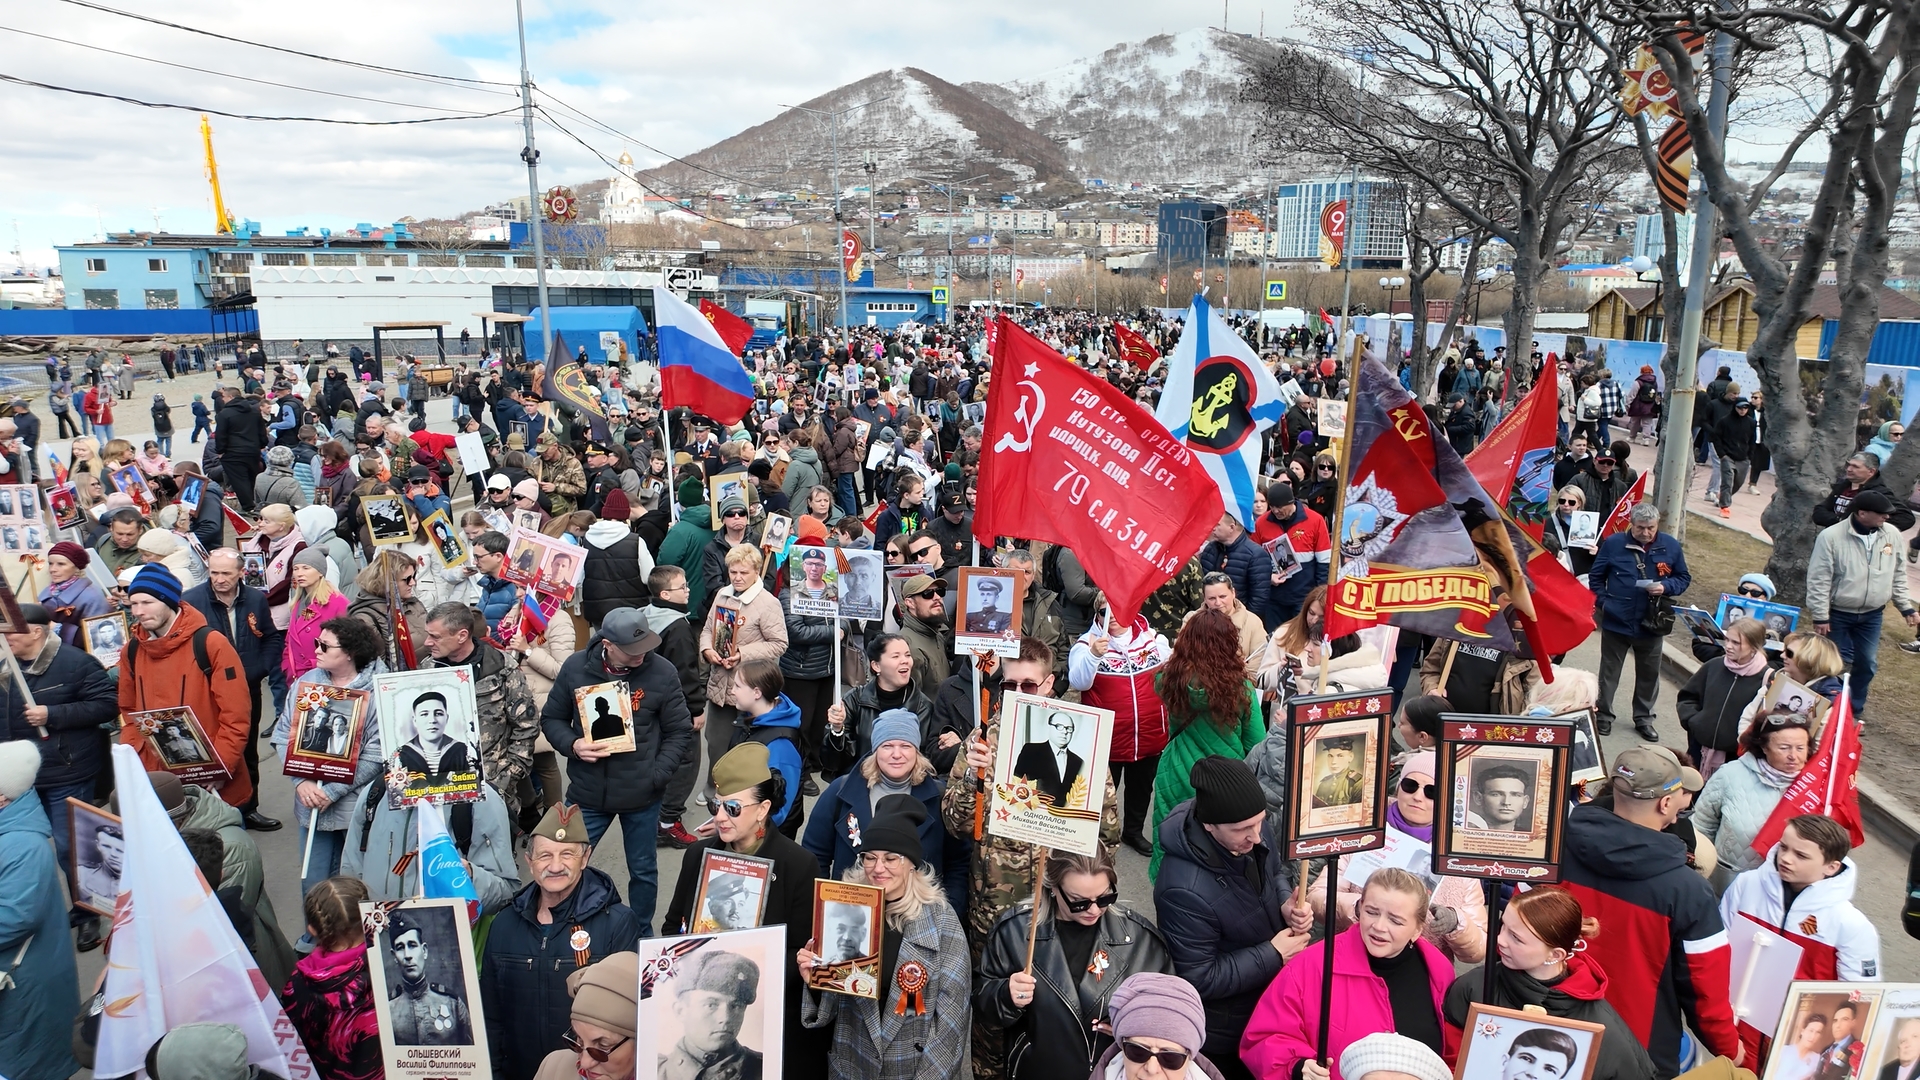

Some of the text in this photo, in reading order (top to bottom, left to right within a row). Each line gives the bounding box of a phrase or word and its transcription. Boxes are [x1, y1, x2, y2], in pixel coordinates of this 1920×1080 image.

[1331, 211, 1345, 232] 9
[846, 240, 855, 255] 9
[1070, 387, 1191, 467] 150 СТР. ОРДЕНА
[1049, 426, 1131, 489] ИДРИЦК. ДИВ.
[1154, 468, 1177, 491] СТ.
[952, 495, 962, 504] Z
[1053, 460, 1090, 505] 79
[1087, 499, 1118, 533] С.К.
[1342, 581, 1358, 605] С
[1381, 577, 1490, 604] ПОБЕДЫ!
[452, 773, 477, 782] Зябко
[428, 783, 478, 795] Васильевич
[1012, 815, 1077, 834] Михаил Васильевич
[1023, 811, 1067, 825] ОДНОПАЛОВ
[407, 1048, 461, 1059] ОЛЬШЕВСКИЙ
[396, 1059, 476, 1069] Василий Филиппович
